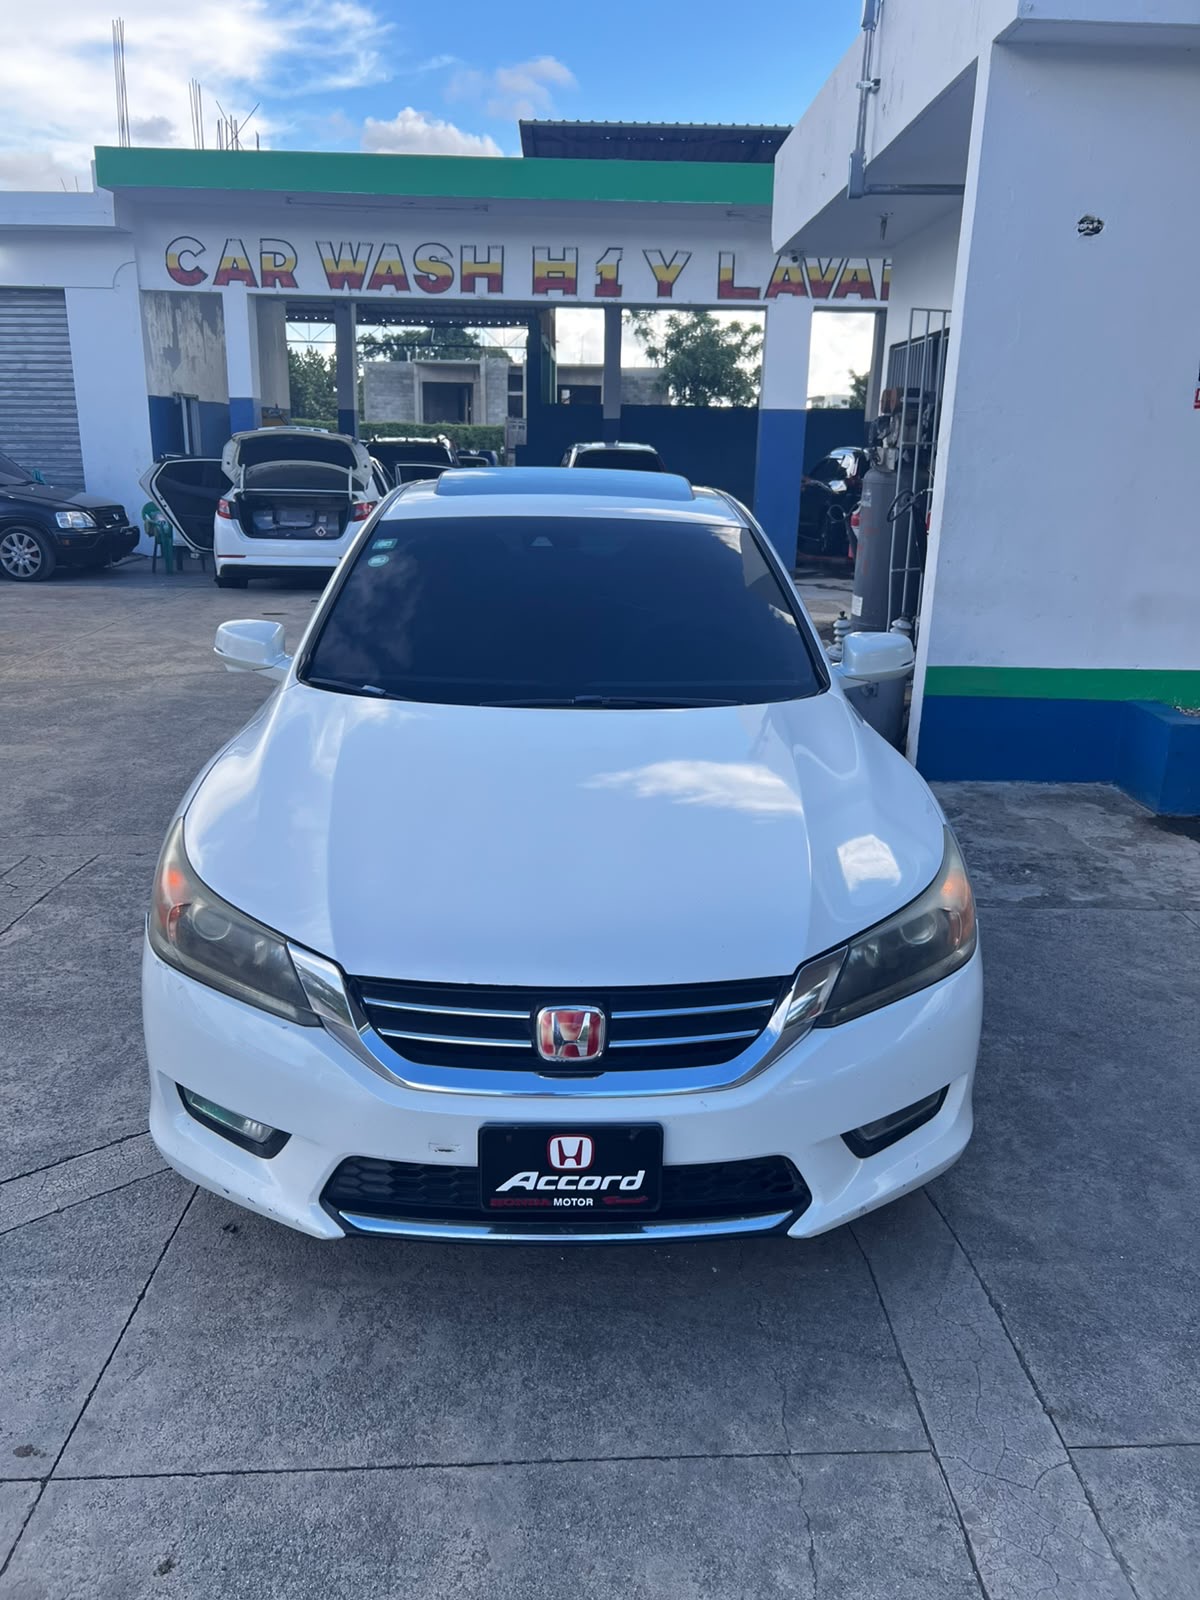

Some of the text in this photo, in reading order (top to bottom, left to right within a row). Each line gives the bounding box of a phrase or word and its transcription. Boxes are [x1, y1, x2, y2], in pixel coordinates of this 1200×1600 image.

[165, 235, 299, 288] CAR
[315, 240, 504, 294] WASH
[642, 249, 692, 298] Y
[717, 250, 893, 301] LAVA
[495, 1169, 646, 1192] Accord
[553, 1198, 594, 1206] MOTOR
